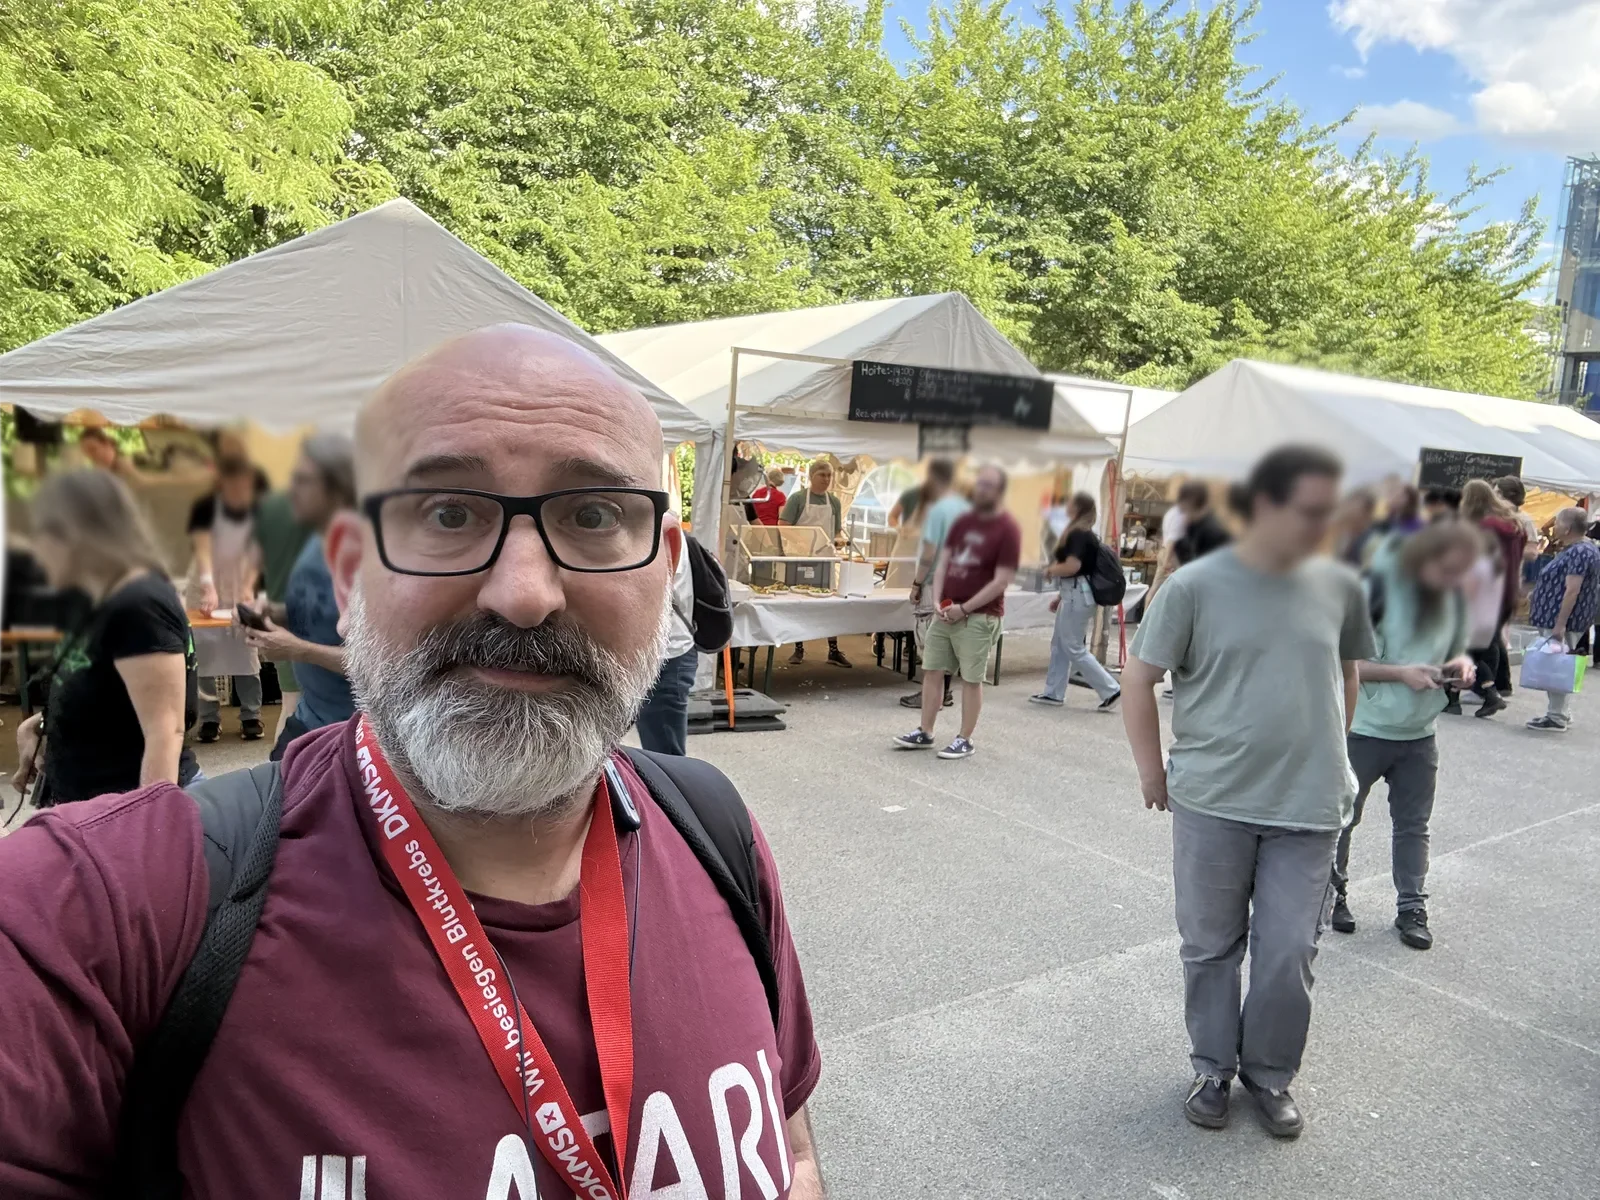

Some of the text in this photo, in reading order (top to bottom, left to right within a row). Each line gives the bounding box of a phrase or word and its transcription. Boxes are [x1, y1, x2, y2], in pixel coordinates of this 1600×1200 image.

[361, 764, 409, 840] DKMS
[405, 840, 545, 1096] Wir besiegen Blutkrebs
[549, 1127, 611, 1200] DKMS
